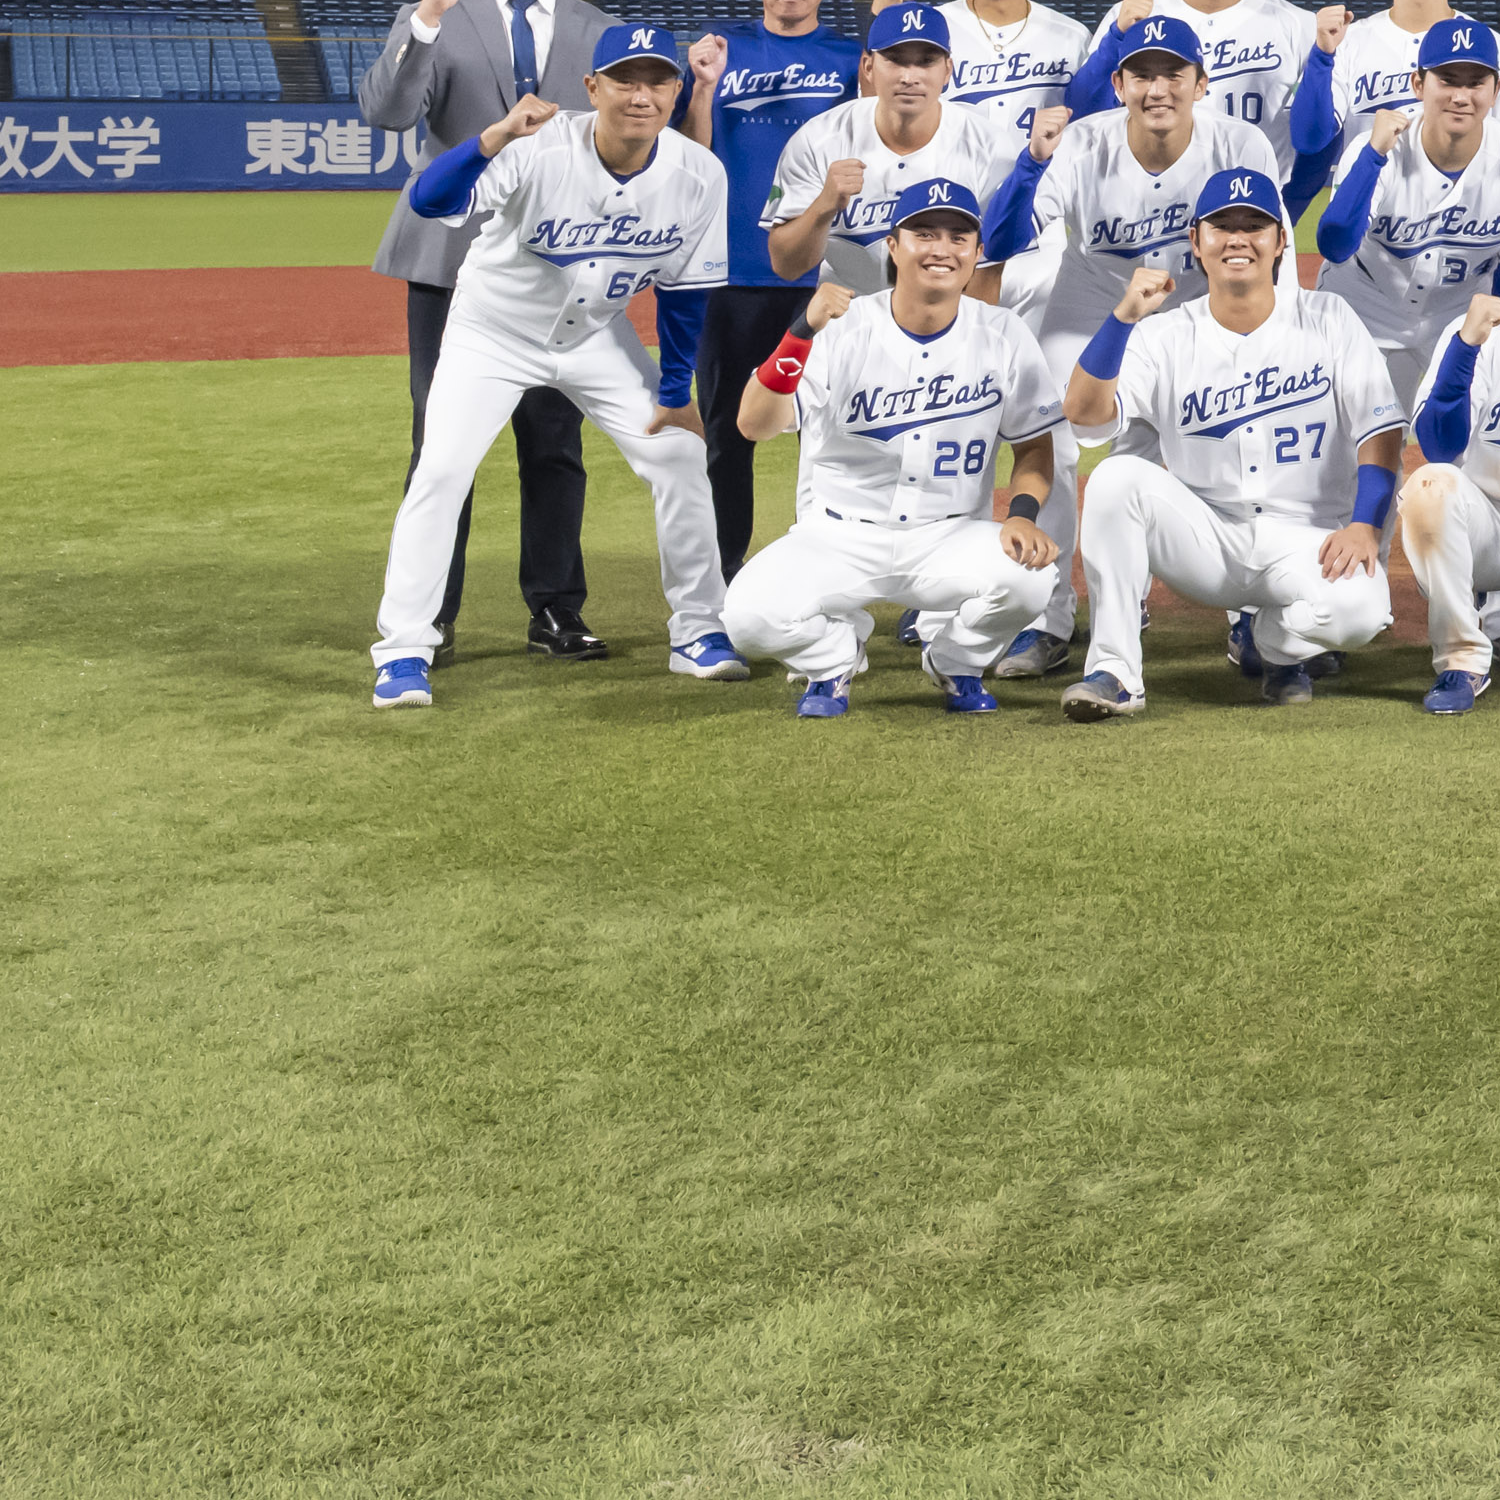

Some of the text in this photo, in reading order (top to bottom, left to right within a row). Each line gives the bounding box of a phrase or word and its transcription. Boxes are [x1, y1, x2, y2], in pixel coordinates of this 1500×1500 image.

[1224, 93, 1261, 124] 10
[935, 440, 986, 477] 28
[1274, 422, 1326, 464] 27
